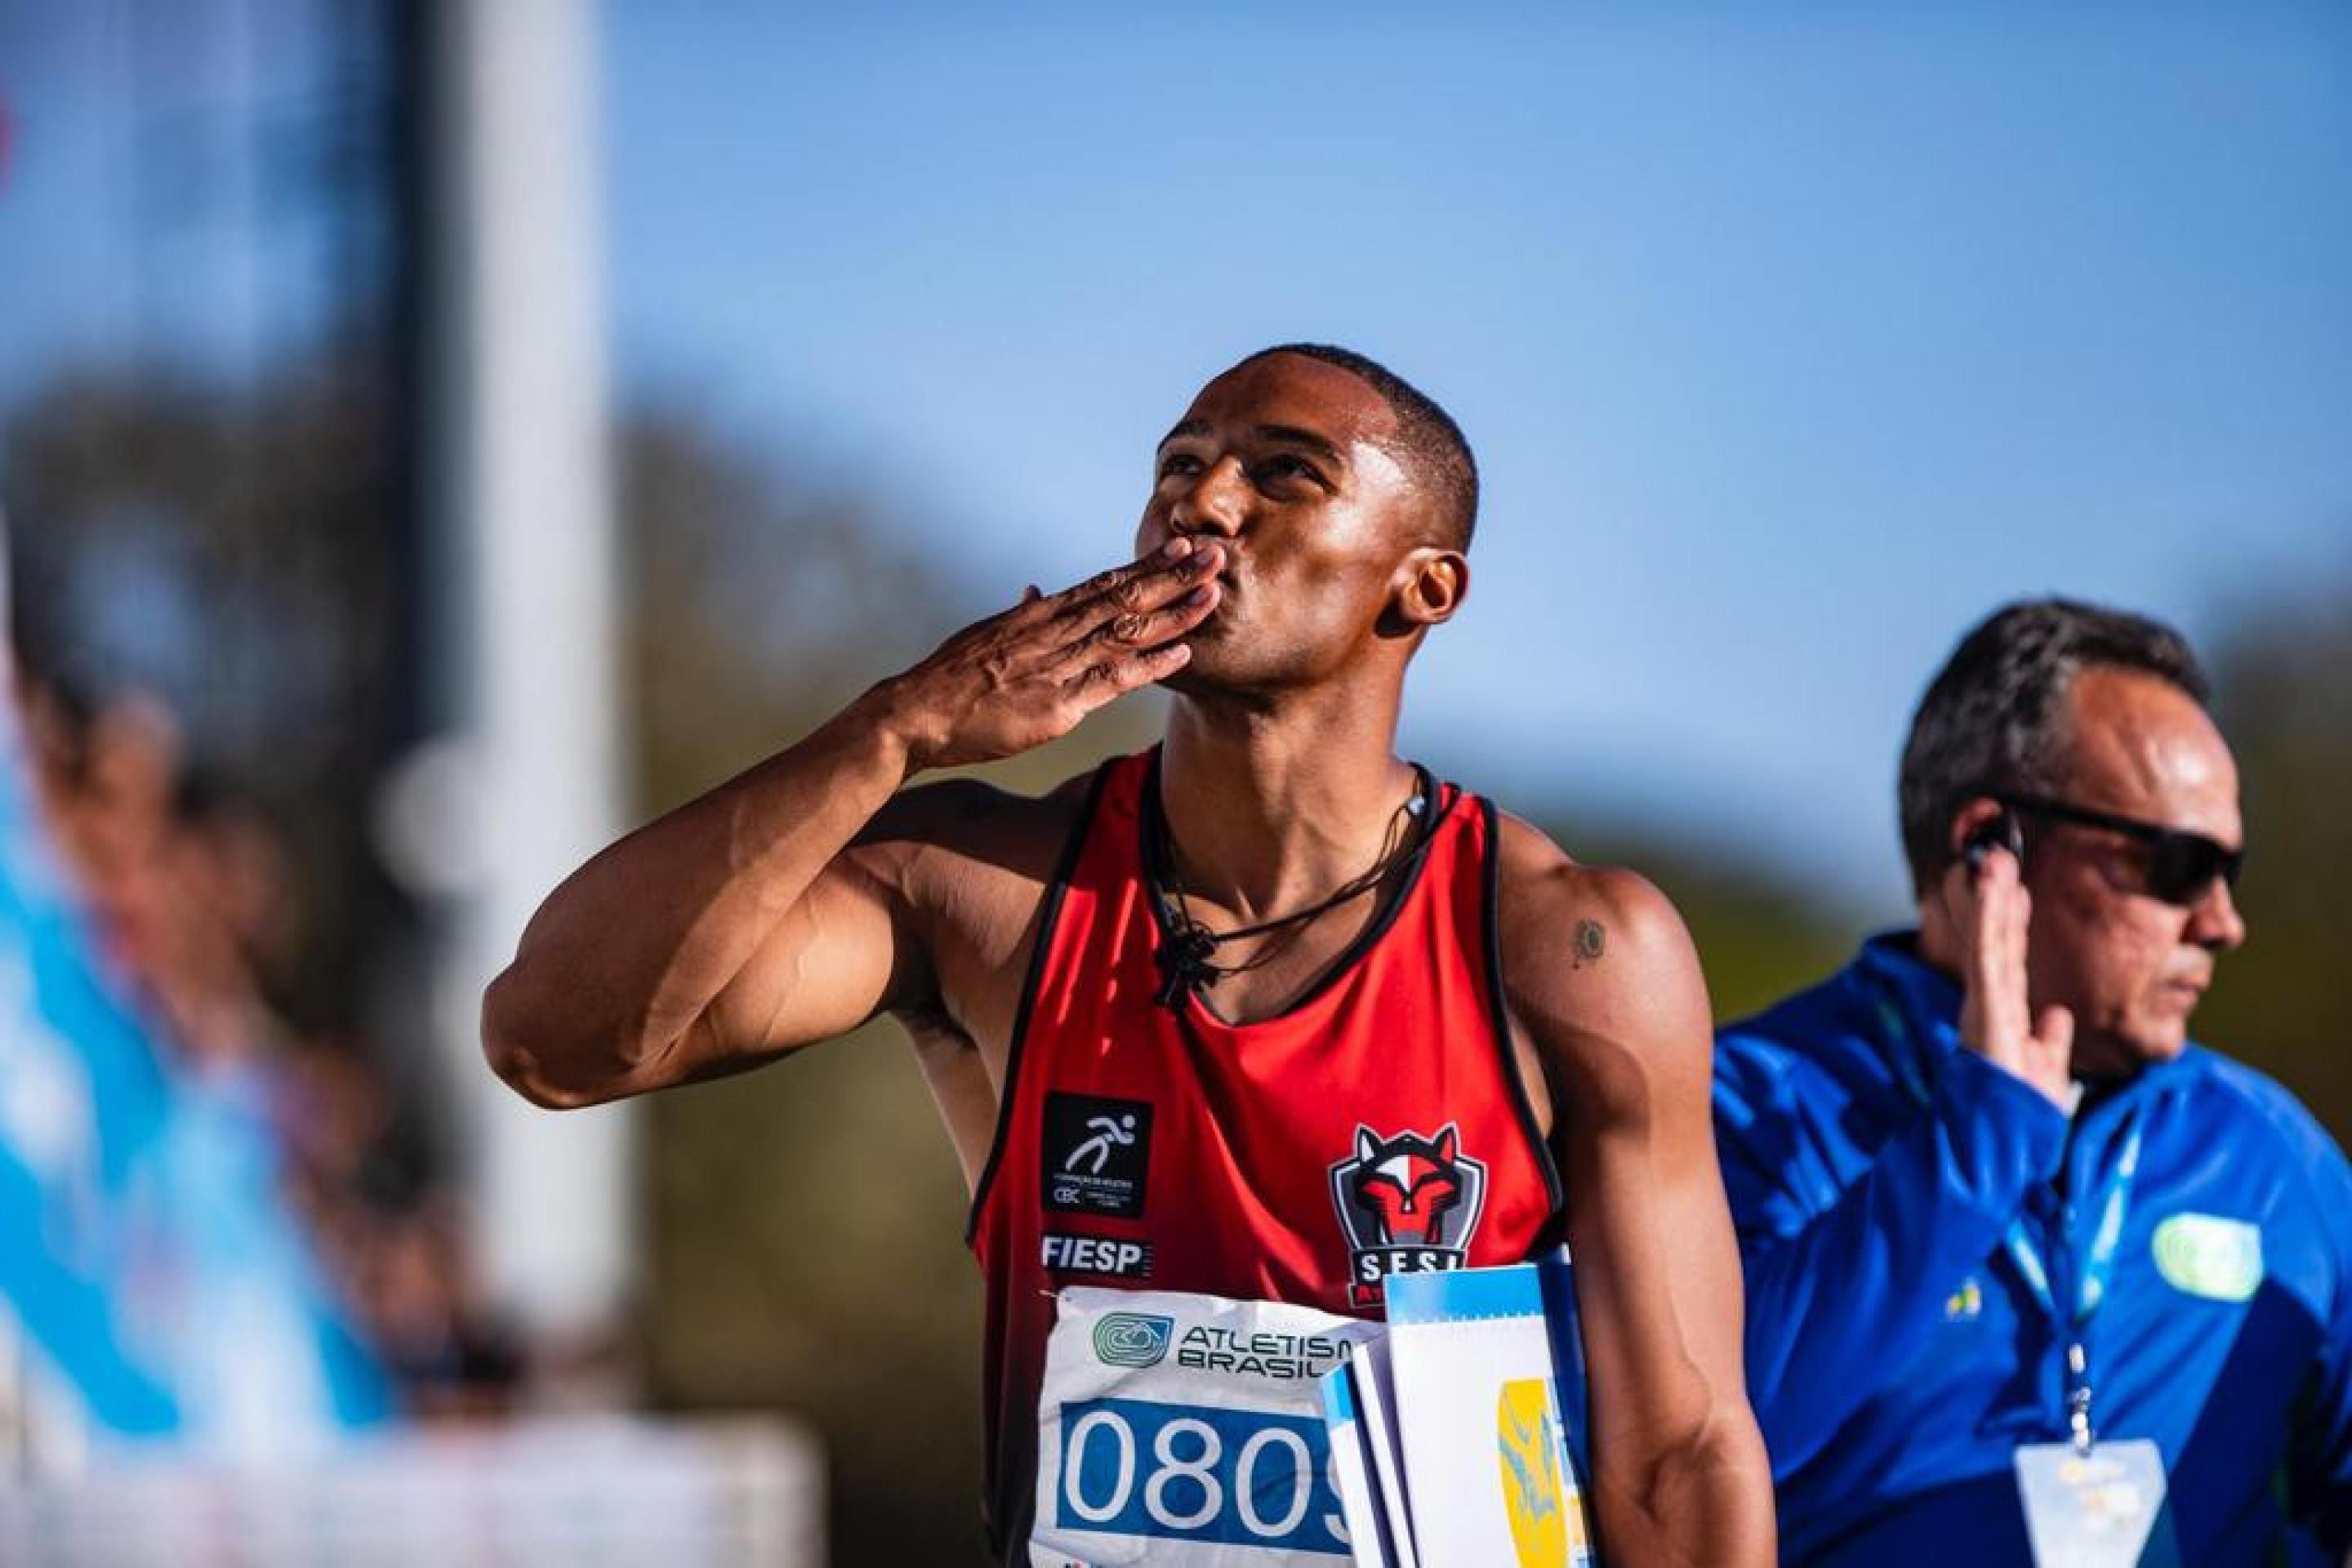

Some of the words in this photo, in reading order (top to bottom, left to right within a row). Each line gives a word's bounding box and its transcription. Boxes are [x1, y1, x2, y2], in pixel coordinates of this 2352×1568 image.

[1042, 1235, 1143, 1272] FIESP
[1361, 1251, 1457, 1281] SESI
[1178, 1348, 1324, 1379] BRASIL
